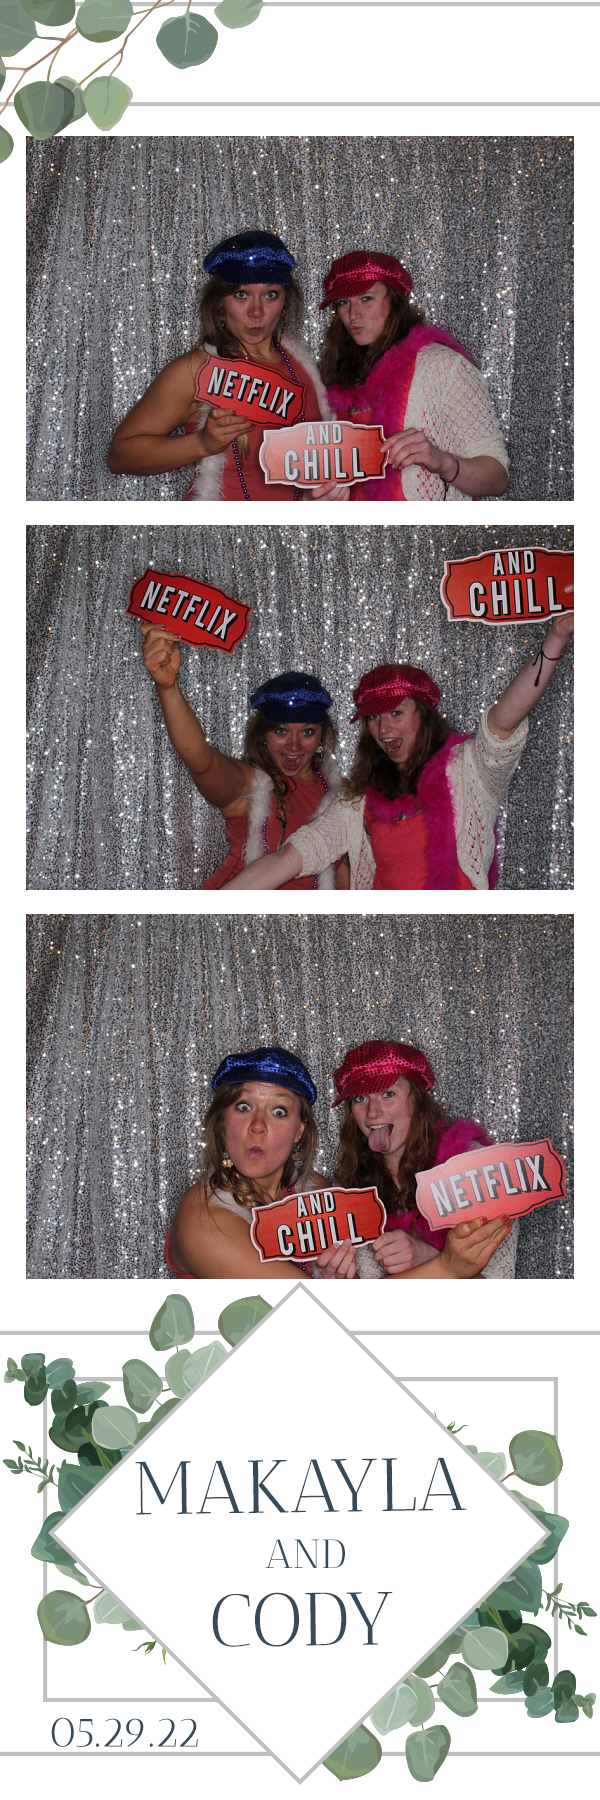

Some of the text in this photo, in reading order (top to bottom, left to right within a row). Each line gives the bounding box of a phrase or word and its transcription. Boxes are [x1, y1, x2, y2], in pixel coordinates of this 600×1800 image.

[207, 366, 295, 420] NETFLIX
[305, 423, 342, 445] AND
[284, 447, 366, 481] CHILL
[493, 550, 537, 576] AND
[140, 580, 238, 642] NETFLIX
[469, 576, 564, 617] CHILL
[297, 1191, 336, 1218] AND
[429, 1154, 552, 1217] NETFLIX
[276, 1213, 364, 1257] CHILL
